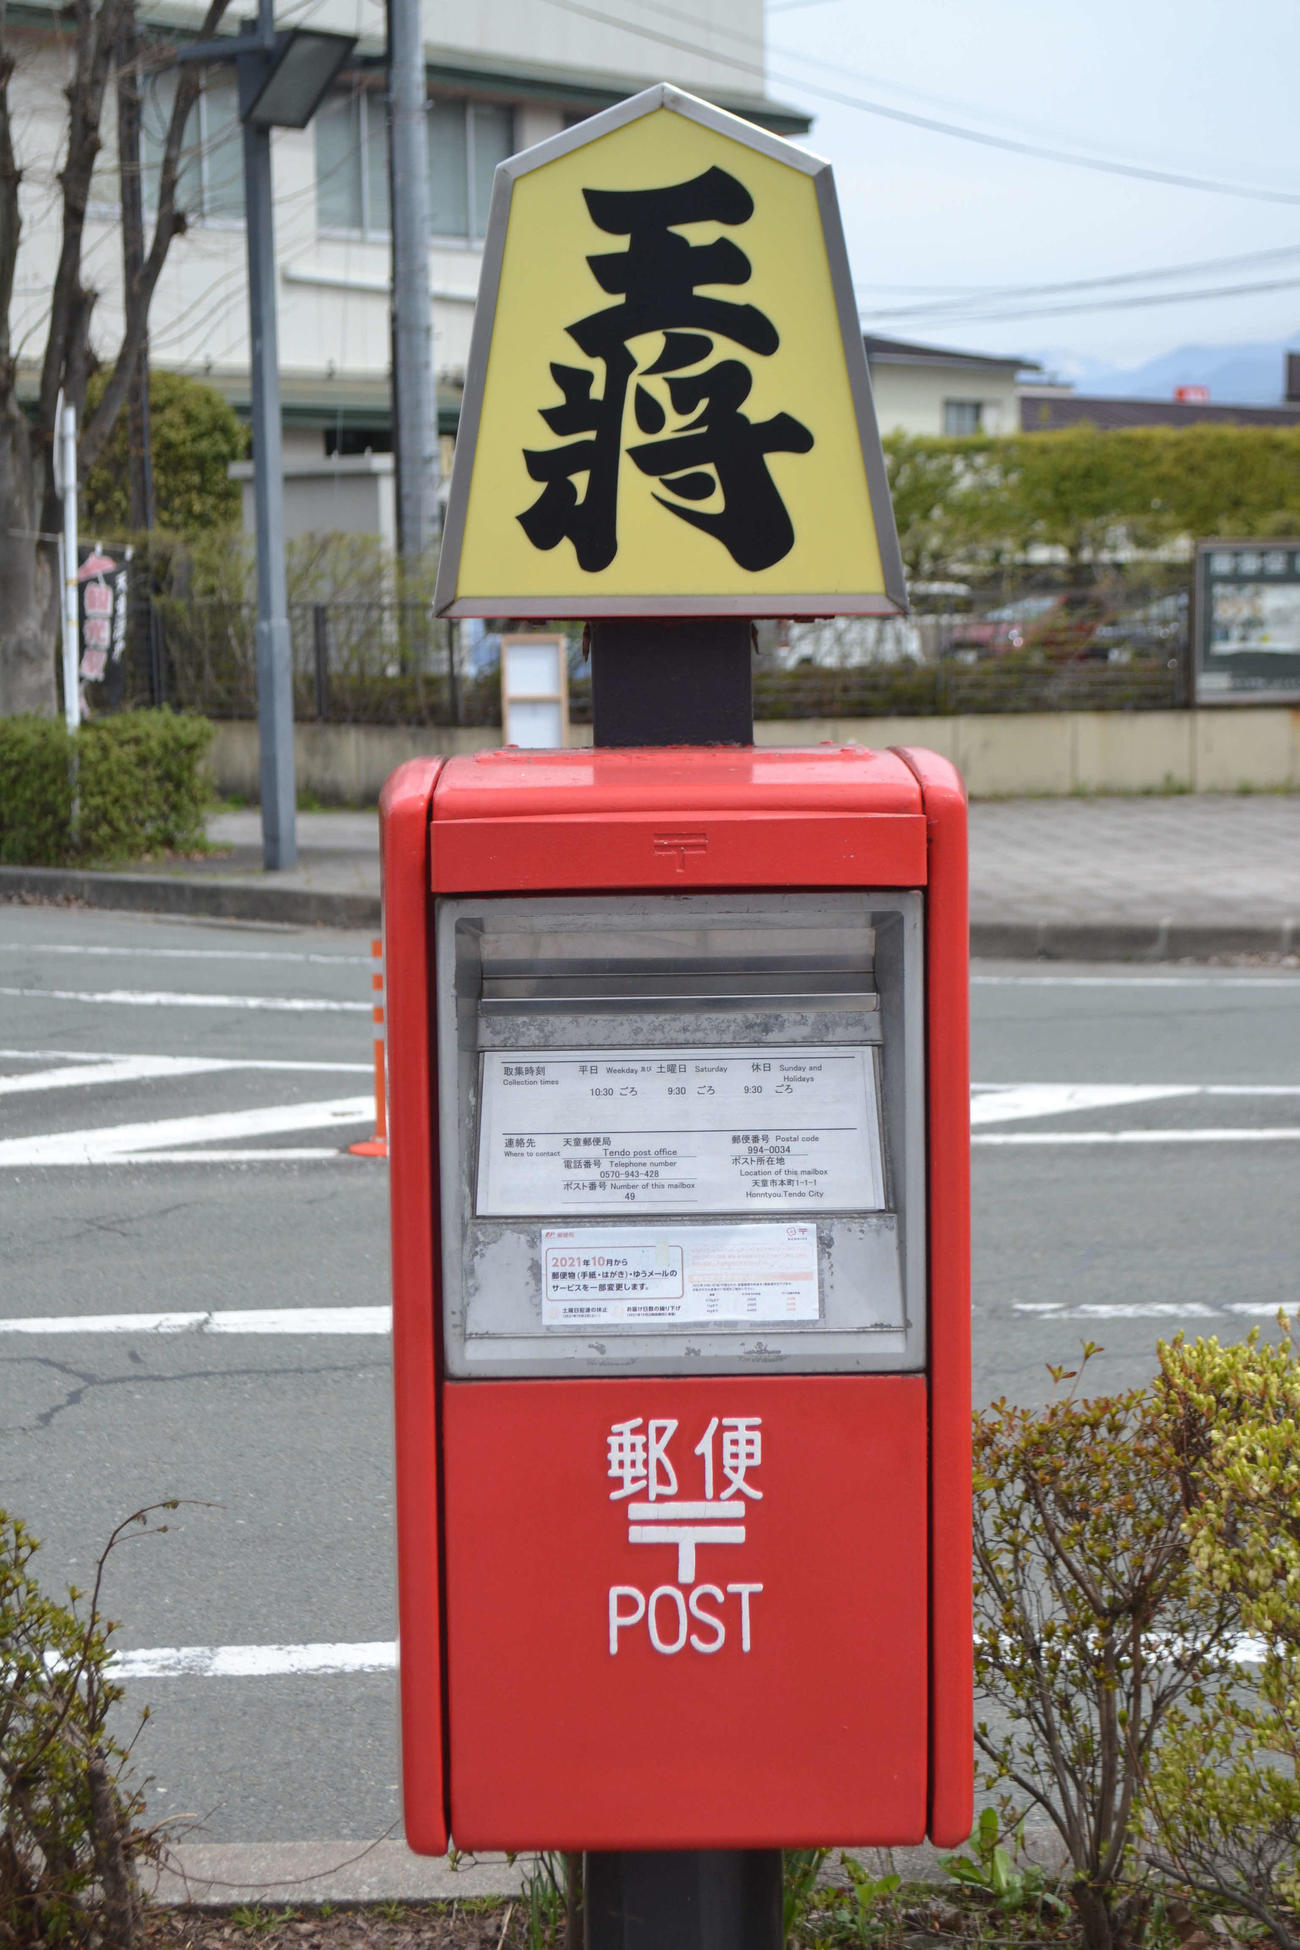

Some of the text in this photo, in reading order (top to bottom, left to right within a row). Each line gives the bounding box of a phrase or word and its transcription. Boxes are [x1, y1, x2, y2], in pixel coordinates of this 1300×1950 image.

[578, 1065, 599, 1075] 平日
[605, 1066, 638, 1075] Weekday
[656, 1063, 728, 1074] 土曜日 Saturday
[751, 1062, 823, 1073] 休日 Sunday and
[503, 1078, 559, 1086] Collection times
[783, 1074, 814, 1083] Holidays
[590, 1086, 638, 1096] 10:30 ごろ
[667, 1085, 716, 1095] 9:30 ごろ
[743, 1084, 794, 1094] 9:30 ごろ
[504, 1138, 536, 1148] 連絡先
[562, 1136, 611, 1147] 天童郵便局
[731, 1134, 820, 1145] 郵便番号 Postal code
[603, 1148, 678, 1158] Tendo post office
[747, 1145, 791, 1155] 994-0034
[563, 1159, 677, 1169] 電話番号 Telephone number
[731, 1156, 786, 1167] ポスト所在地
[599, 1170, 660, 1179] 0570-943-428
[739, 1168, 829, 1177] Location of this mailbox
[563, 1181, 696, 1192] ポスト番号 Number of this mailbox
[624, 1191, 636, 1201] 49
[808, 1190, 824, 1198] City
[551, 1255, 628, 1268] 2021年10月から
[607, 1417, 763, 1501] 郵便
[608, 1583, 763, 1655] POST
